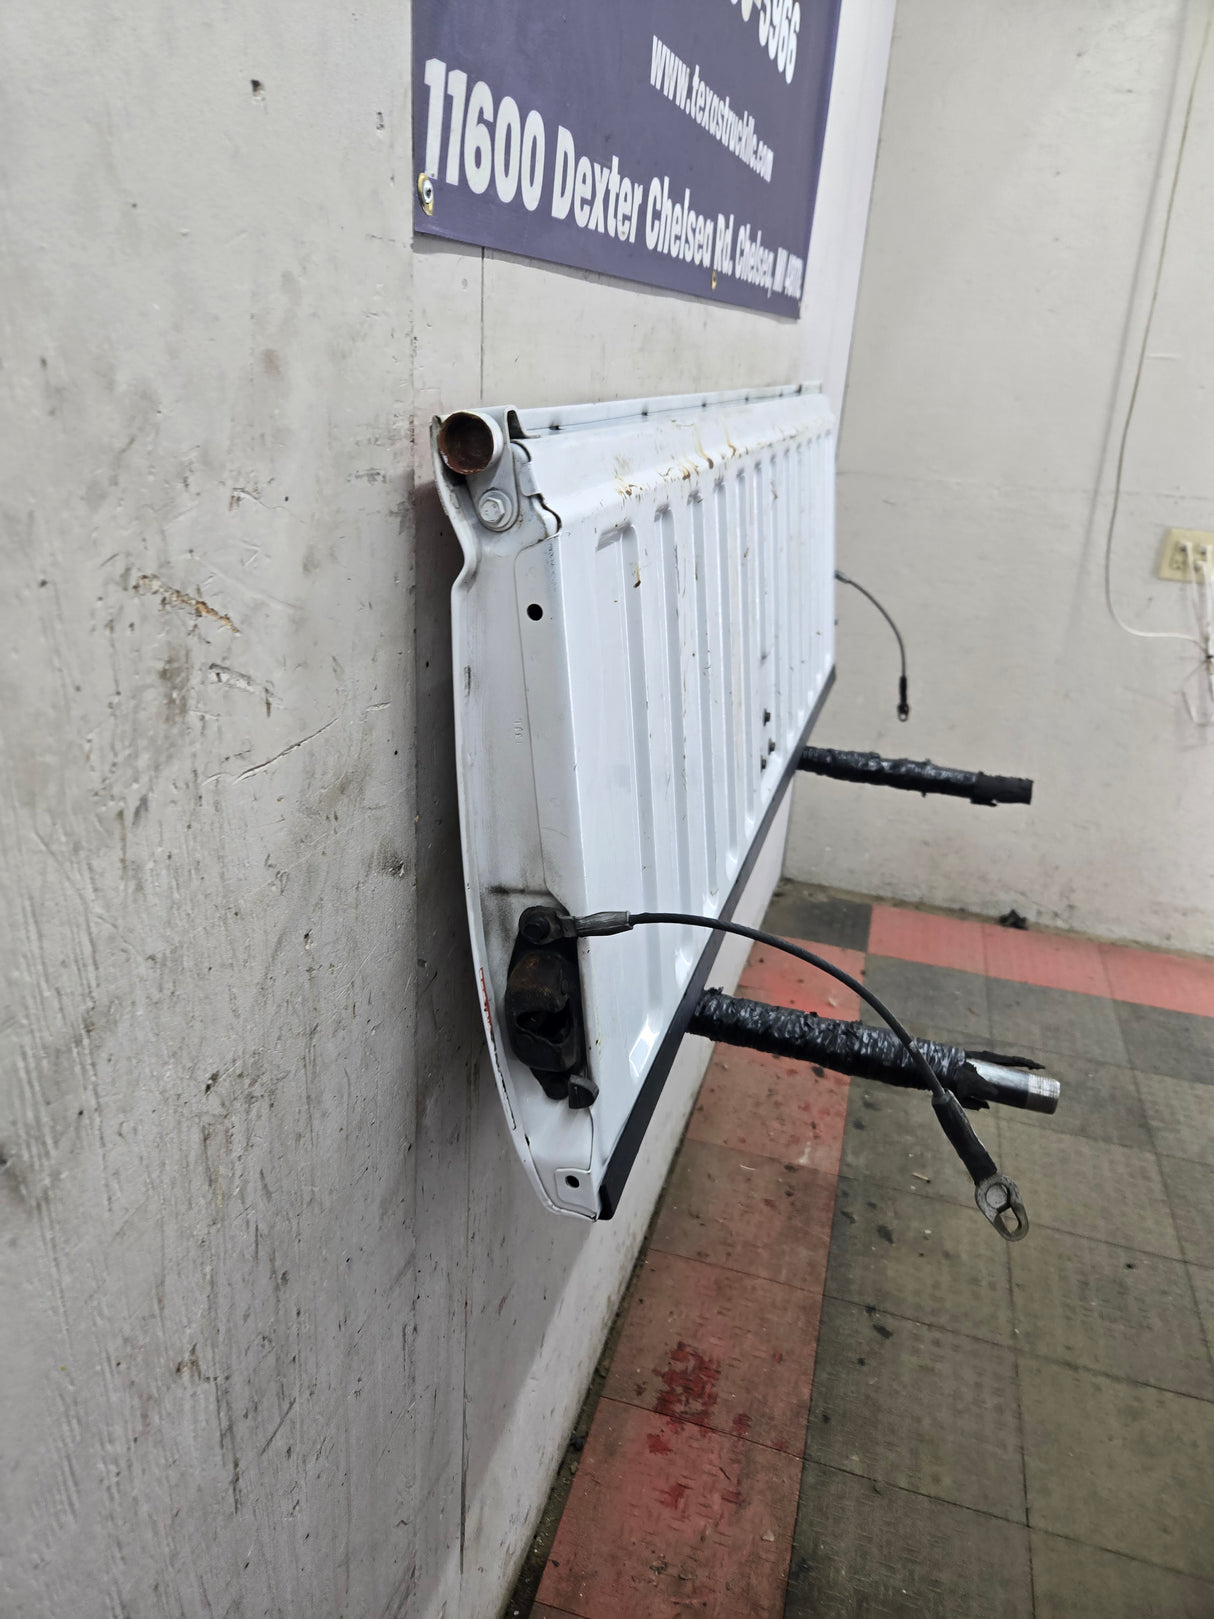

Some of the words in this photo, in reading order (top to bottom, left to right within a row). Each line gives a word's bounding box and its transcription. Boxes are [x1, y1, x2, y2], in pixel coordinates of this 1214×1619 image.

[424, 58, 545, 212] 11600
[552, 125, 643, 243] Dexter
[646, 176, 715, 268] Chelsea
[714, 213, 735, 276] Rd.
